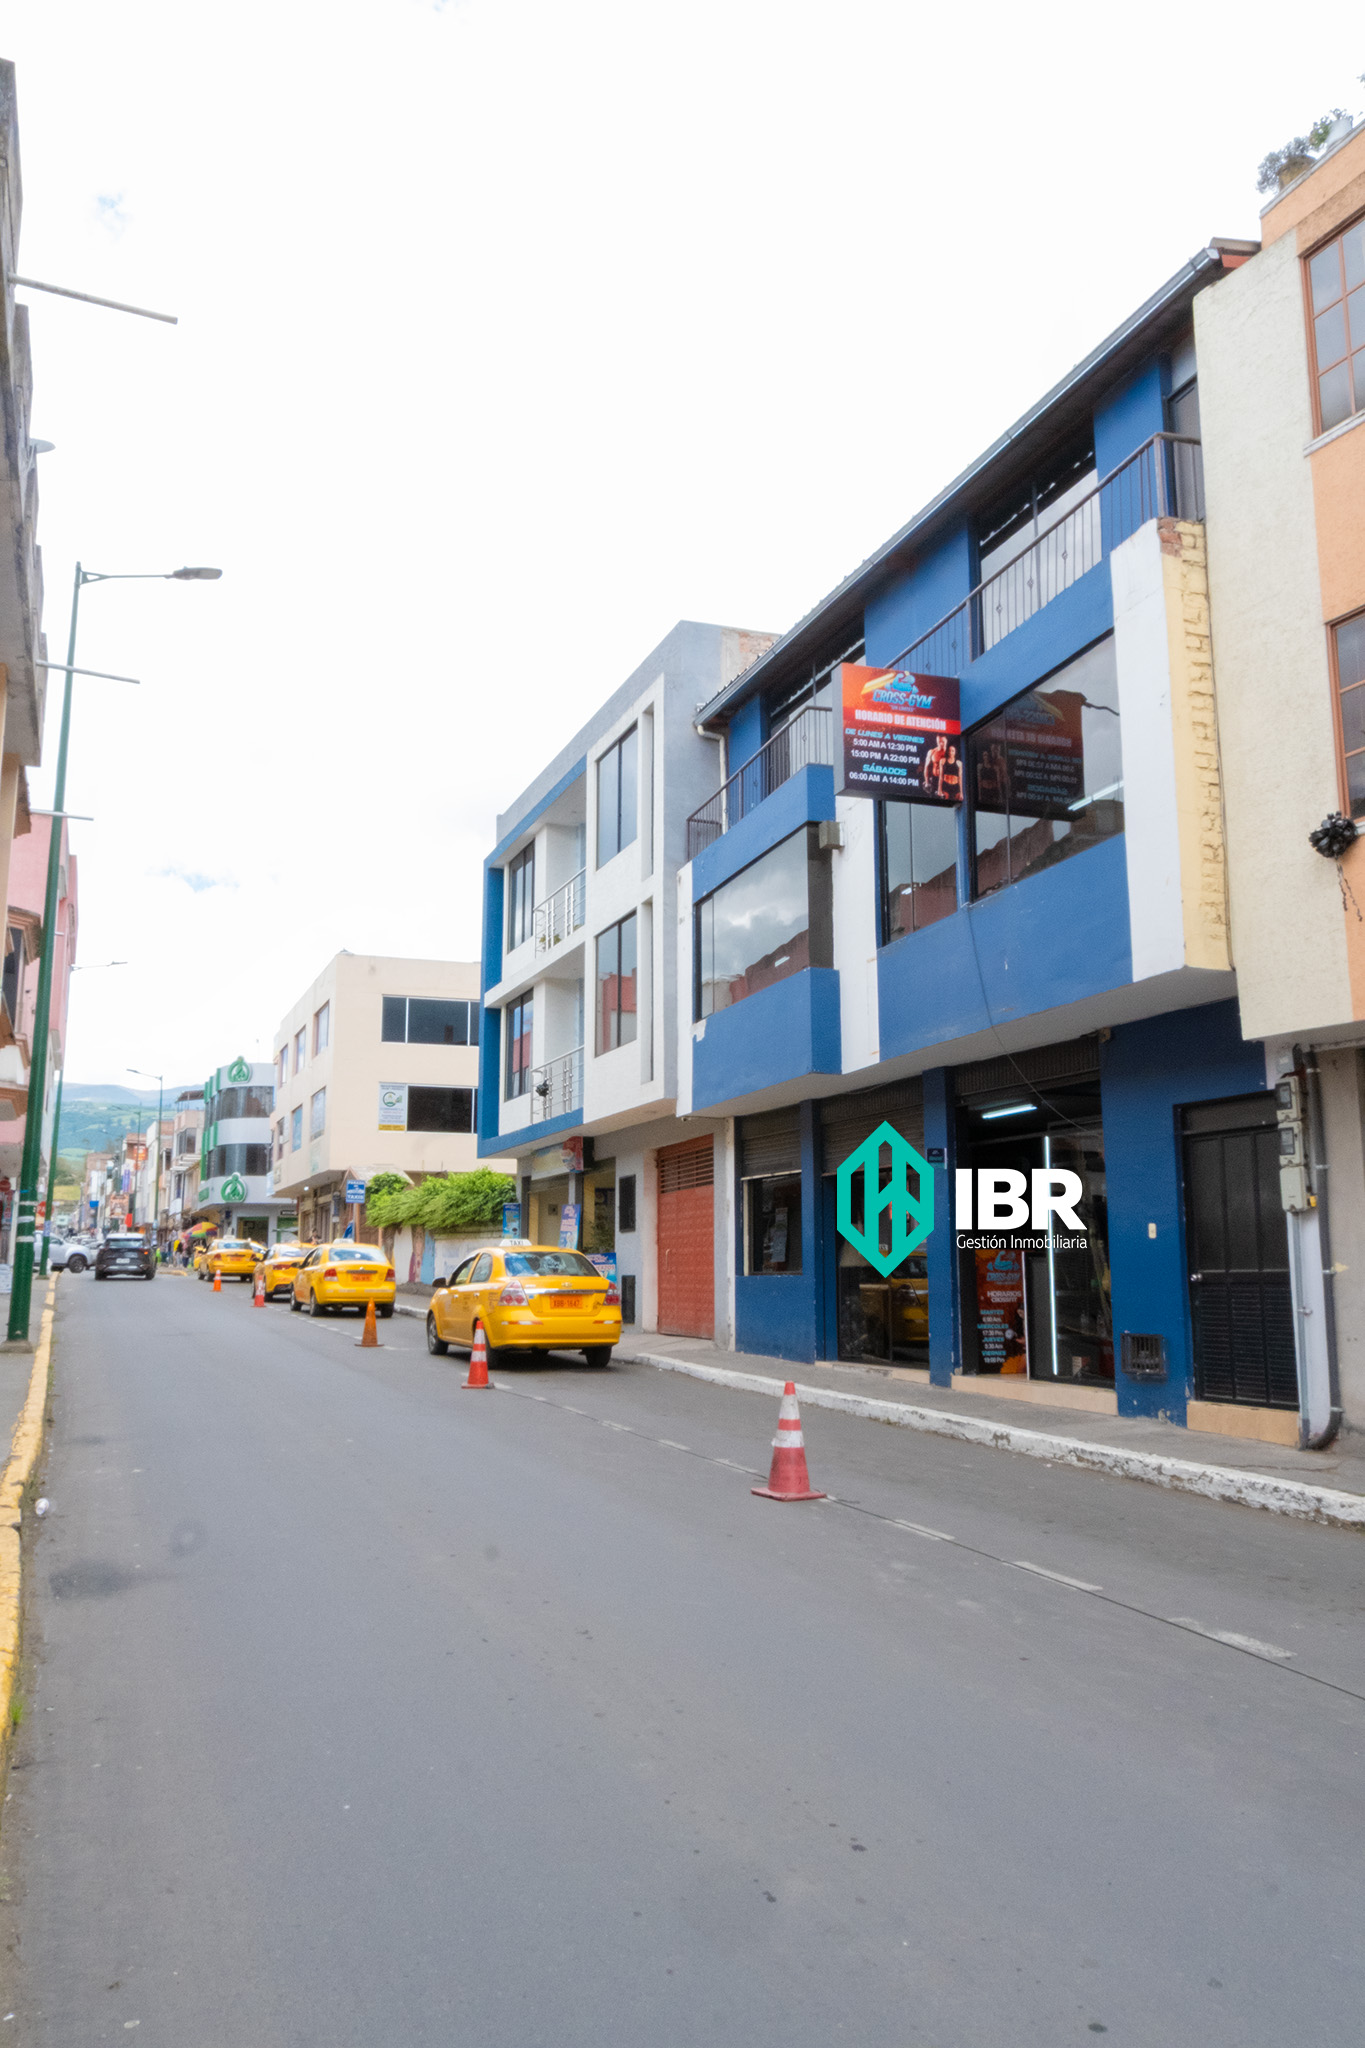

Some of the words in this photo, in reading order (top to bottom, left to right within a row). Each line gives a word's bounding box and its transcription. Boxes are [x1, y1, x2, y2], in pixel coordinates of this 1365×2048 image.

[873, 690, 936, 709] CROSS-GYM
[855, 709, 893, 723] HORARIO
[894, 714, 905, 725] DE
[906, 716, 946, 730] ATENCIÓN
[858, 730, 883, 738] LUNES
[893, 734, 925, 744] VIERNES
[853, 738, 868, 746] 5:00
[888, 742, 905, 751] 12:30
[851, 750, 869, 758] 15:00
[870, 751, 881, 759] PM
[890, 754, 907, 763] 22:00
[863, 763, 907, 776] SÁBADOS
[849, 772, 868, 780] 06:00
[868, 774, 880, 782] AM
[889, 776, 907, 785] 14:00
[908, 778, 918, 786] PM
